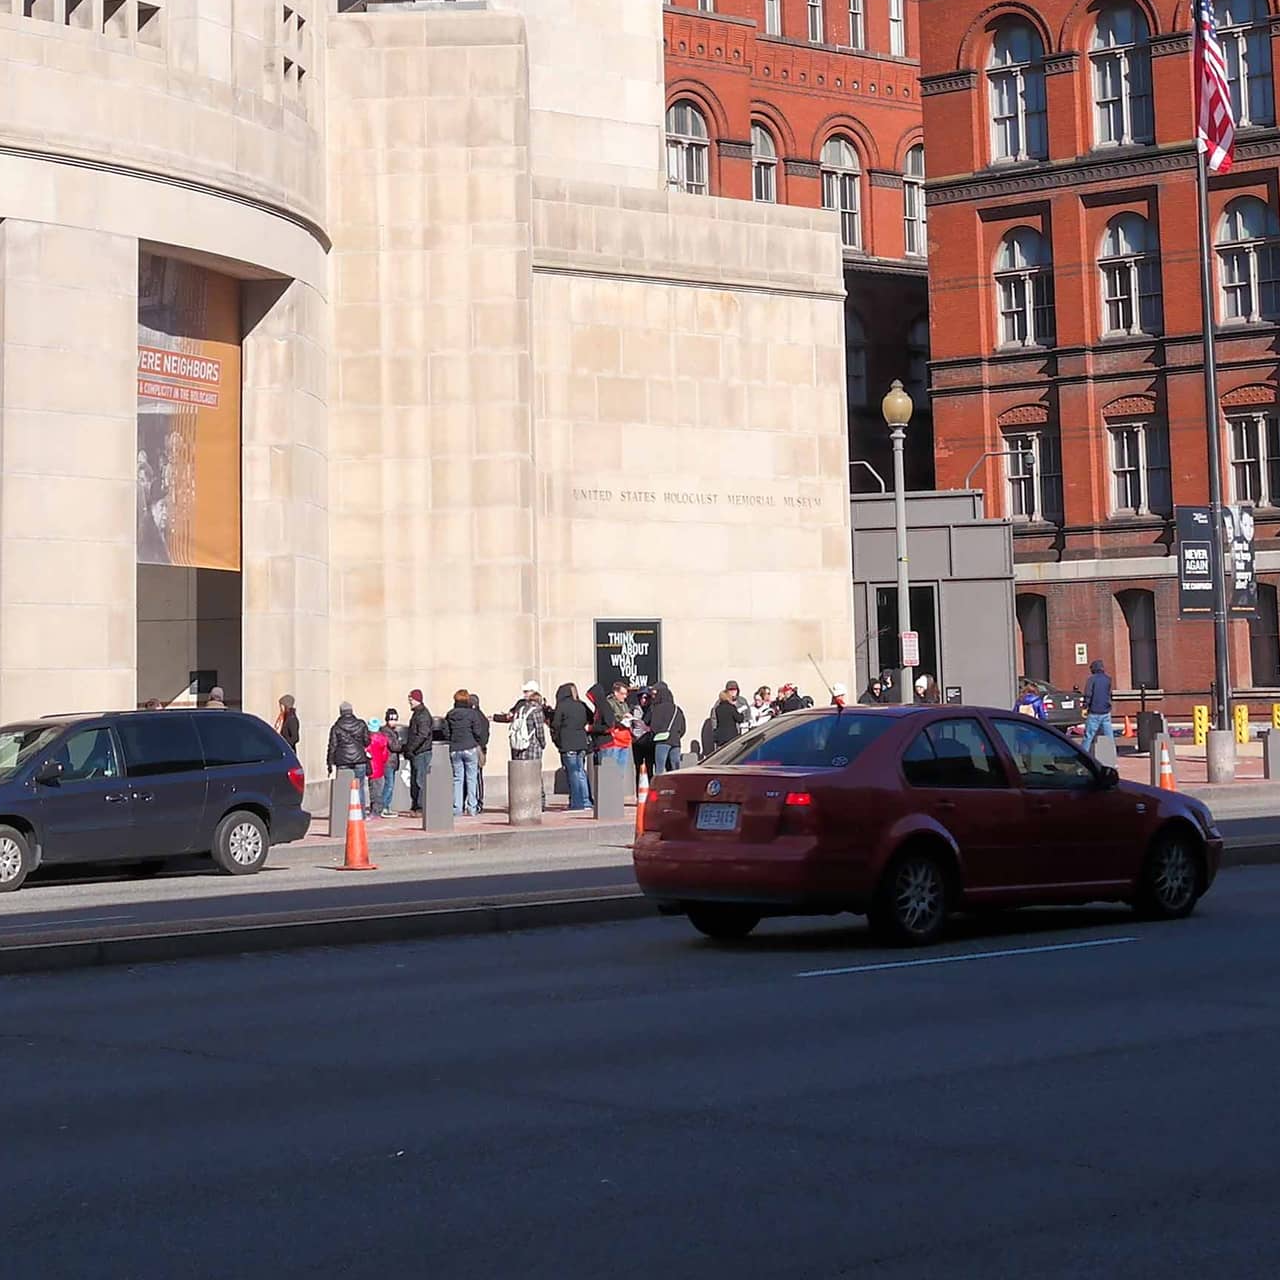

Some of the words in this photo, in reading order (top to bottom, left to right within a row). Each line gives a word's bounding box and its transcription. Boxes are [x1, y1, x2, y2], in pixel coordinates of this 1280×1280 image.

[163, 354, 219, 381] NEIGHBORS
[572, 488, 613, 502] UNITED
[620, 490, 657, 503] STATES
[663, 491, 718, 505] HOLOCAUST
[727, 495, 776, 507] MEMORIAL
[1184, 549, 1208, 560] NEVER
[1185, 560, 1208, 570] AGAIN
[607, 631, 635, 645] THINK
[621, 642, 649, 656] ABOUT
[610, 654, 635, 667] WHAT
[619, 664, 638, 677] YOU
[628, 675, 648, 688] SAW
